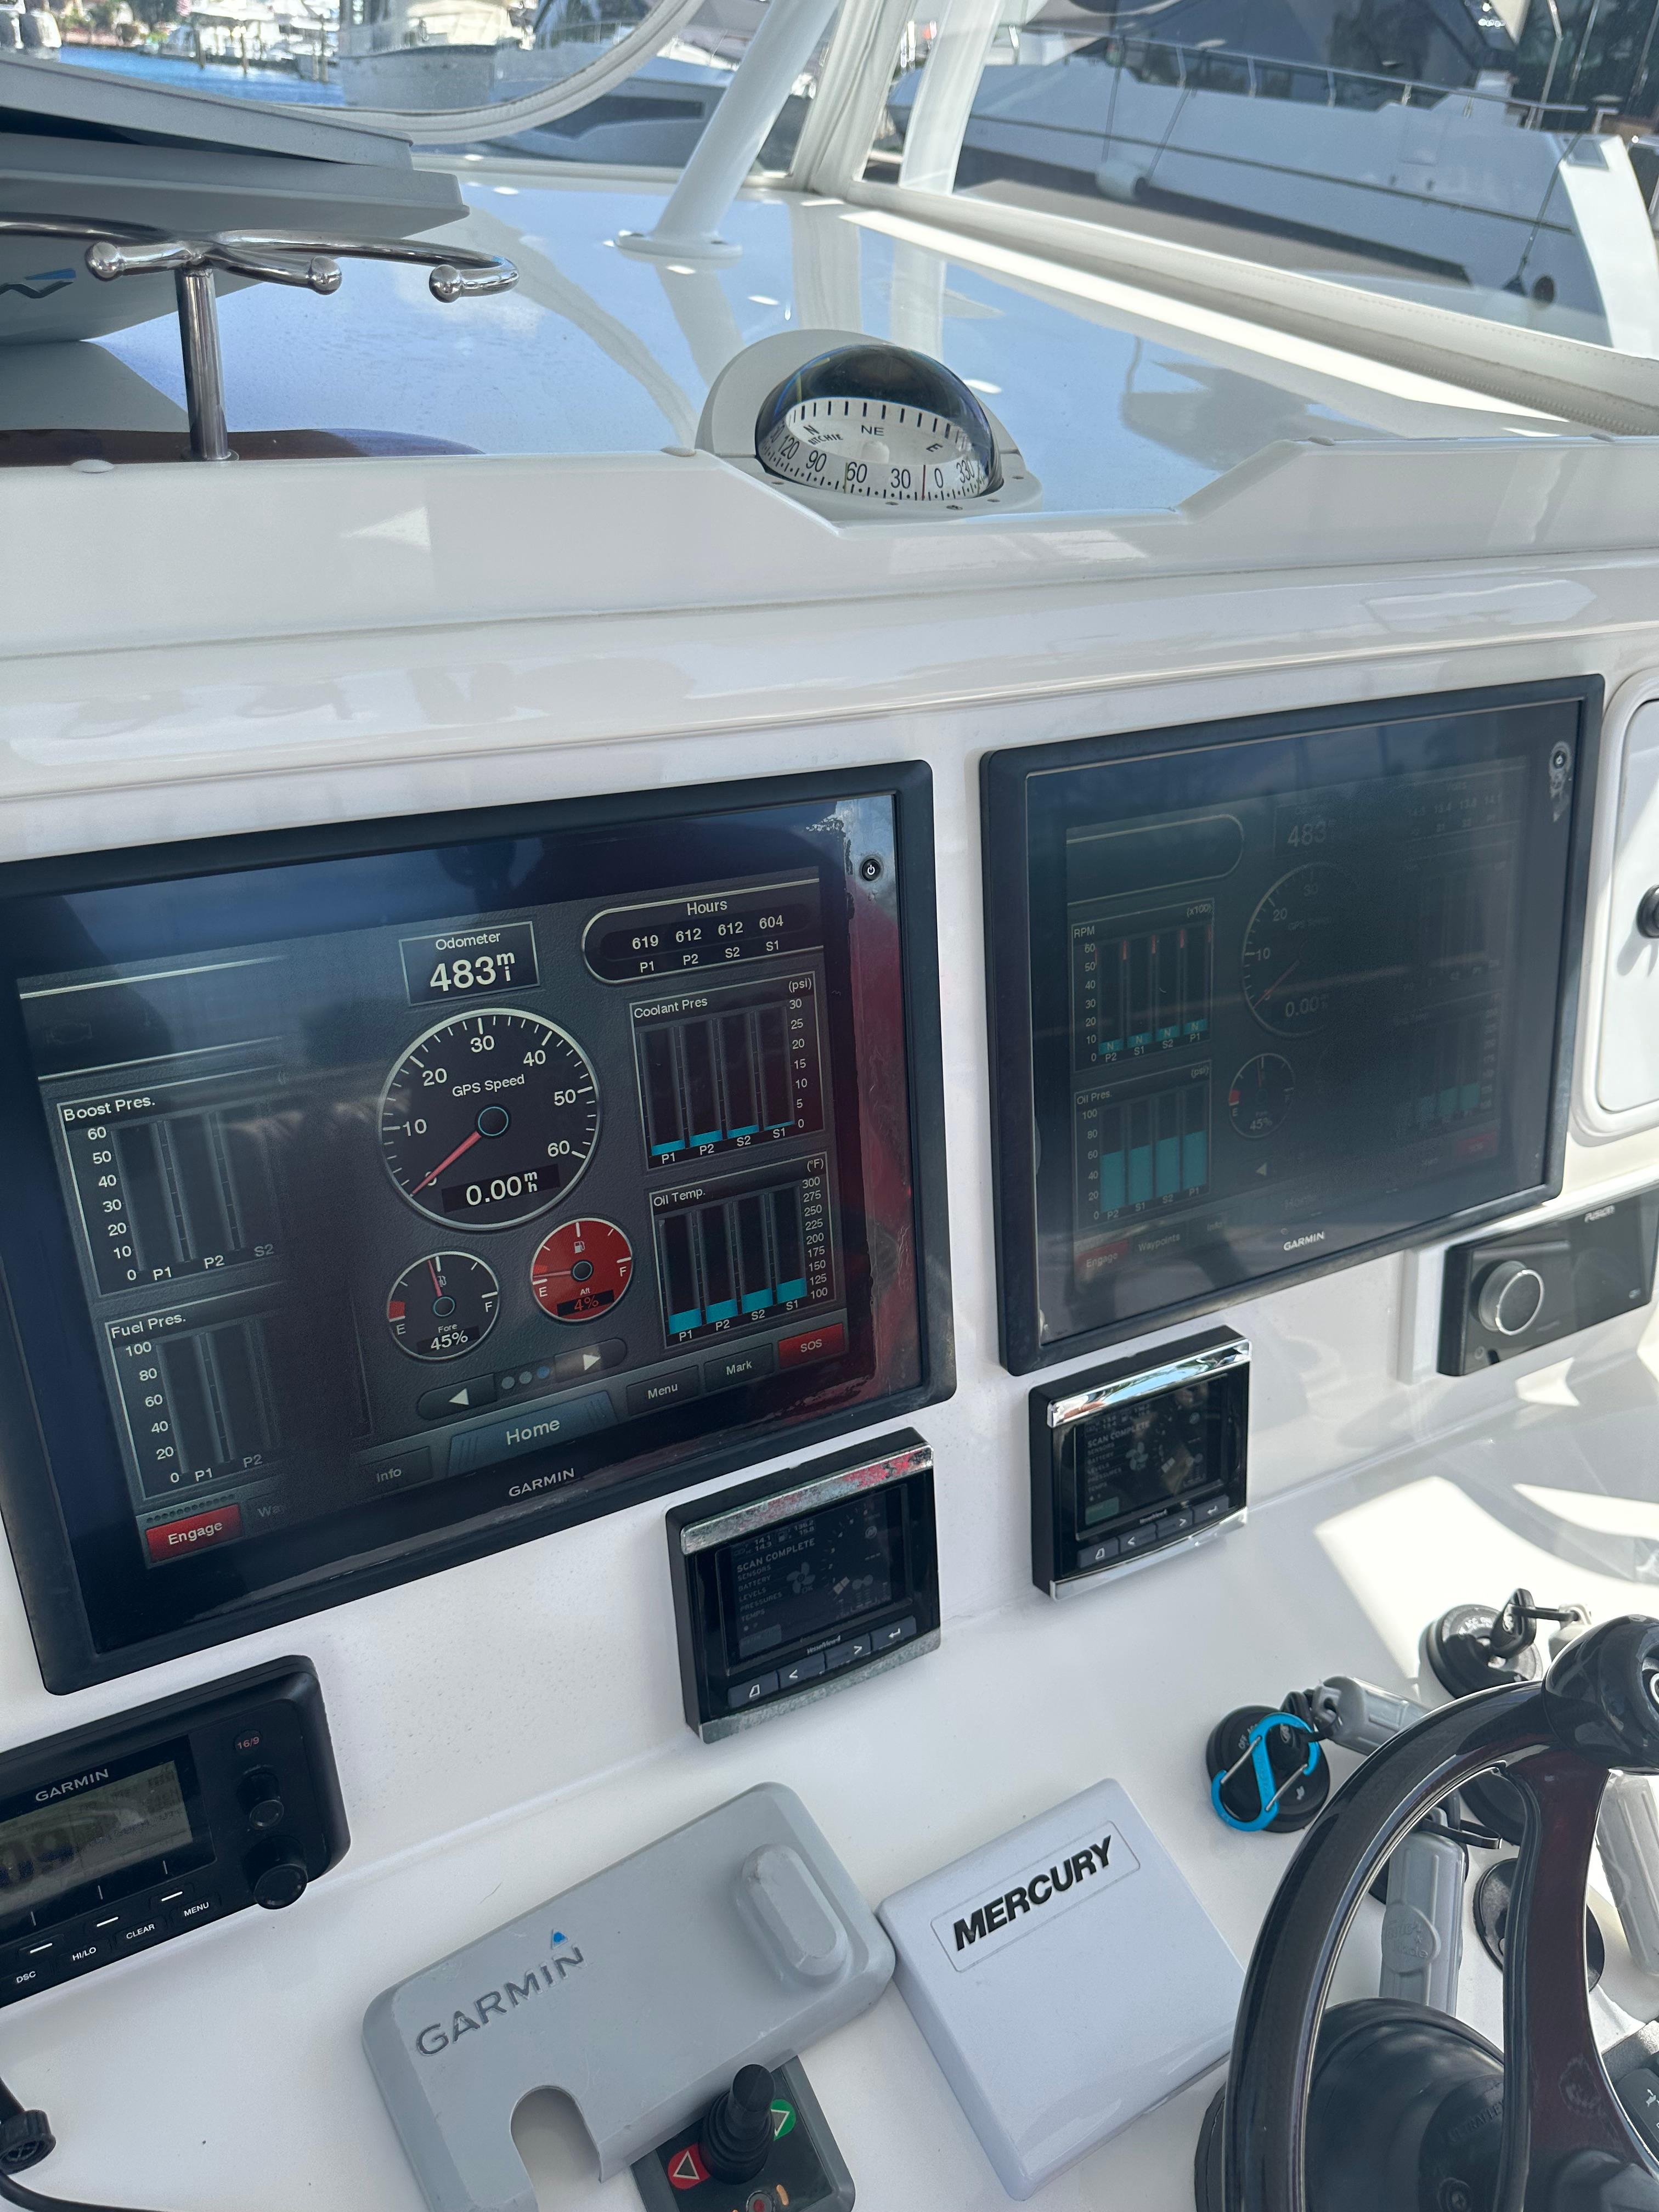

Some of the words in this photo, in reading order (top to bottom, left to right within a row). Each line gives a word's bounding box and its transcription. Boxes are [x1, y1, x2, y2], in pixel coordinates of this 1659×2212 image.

[803, 424, 820, 436] N
[860, 425, 885, 437] NE
[777, 435, 800, 460] 120
[926, 443, 944, 453] E
[805, 450, 827, 472] 90
[847, 461, 867, 483] 60
[890, 468, 911, 489] 30
[934, 468, 944, 488] 0
[956, 459, 975, 484] 330
[686, 899, 728, 916] Hours
[1273, 908, 1288, 922] 20
[631, 934, 659, 950] 619
[675, 928, 702, 943] 612
[718, 921, 743, 936] 612
[759, 915, 784, 930] 604
[1074, 926, 1095, 939] RPM
[435, 932, 501, 952] Odometer
[1084, 944, 1096, 953] 60
[640, 961, 656, 973] P1
[682, 953, 699, 966] P2
[725, 946, 740, 959] S2
[766, 940, 780, 952] S1
[1255, 947, 1271, 960] 10
[430, 956, 496, 992] 483
[1085, 962, 1096, 972] 50
[788, 978, 812, 993] (psi)
[1085, 980, 1096, 990] 40
[634, 1002, 679, 1019] Coolant
[682, 996, 708, 1013] Pres
[789, 998, 803, 1009] 30
[1085, 998, 1096, 1008] 30
[790, 1018, 804, 1030] 25
[1085, 1017, 1096, 1028] 20
[470, 1036, 495, 1053] 30
[792, 1038, 805, 1050] 20
[1086, 1034, 1097, 1044] 10
[1105, 1053, 1118, 1063] P2
[1134, 1046, 1145, 1056] S1
[1163, 1039, 1173, 1049] S2
[1190, 1032, 1200, 1042] P1
[523, 1049, 546, 1067] 40
[793, 1058, 807, 1070] 15
[1091, 1053, 1097, 1062] 0
[422, 1068, 448, 1086] 20
[795, 1078, 808, 1089] 10
[452, 1082, 481, 1098] GPS
[484, 1074, 525, 1092] Speed
[554, 1088, 576, 1105] 50
[1077, 1093, 1088, 1105] Oil
[64, 1103, 111, 1121] Boost
[115, 1096, 155, 1112] Pres.
[796, 1099, 803, 1109] 5
[1082, 1109, 1098, 1120] 100
[402, 1119, 428, 1136] 10
[797, 1118, 805, 1129] 0
[87, 1127, 106, 1140] 60
[1087, 1130, 1098, 1139] 80
[547, 1140, 571, 1157] 60
[661, 1152, 676, 1164] P1
[699, 1143, 714, 1155] P2
[736, 1135, 751, 1147] S2
[772, 1127, 786, 1138] S1
[93, 1150, 112, 1164] 50
[1087, 1150, 1098, 1160] 60
[98, 1175, 117, 1188] 40
[802, 1177, 821, 1188] 300
[1088, 1170, 1098, 1181] 40
[465, 1176, 522, 1206] 0.00
[653, 1194, 669, 1207] Oil
[673, 1189, 706, 1204] Temp.
[803, 1190, 821, 1203] 275
[1088, 1190, 1099, 1201] 20
[103, 1199, 122, 1213] 30
[804, 1204, 822, 1216] 250
[1107, 1210, 1119, 1220] P2
[1135, 1202, 1146, 1212] S1
[1163, 1194, 1173, 1204] S2
[1189, 1187, 1199, 1197] P1
[1093, 1211, 1099, 1220] 0
[108, 1223, 127, 1237] 20
[805, 1218, 823, 1231] 225
[806, 1233, 824, 1245] 200
[1283, 1231, 1325, 1251] GARMIN
[114, 1246, 132, 1259] 10
[808, 1246, 825, 1258] 175
[153, 1267, 172, 1281] P1
[204, 1255, 225, 1269] P2
[253, 1244, 274, 1257] S2
[809, 1260, 826, 1272] 150
[127, 1270, 137, 1281] 0
[619, 1266, 627, 1277] F
[810, 1274, 827, 1285] 125
[539, 1286, 548, 1297] E
[580, 1287, 590, 1295] Aft
[810, 1288, 828, 1300] 100
[485, 1302, 493, 1312] F
[574, 1298, 600, 1312] 4%
[111, 1322, 144, 1339] Fuel
[148, 1313, 186, 1330] Pres.
[679, 1330, 693, 1342] P1
[715, 1319, 730, 1331] P2
[751, 1309, 765, 1321] S2
[786, 1299, 799, 1310] S1
[396, 1324, 406, 1335] E
[438, 1323, 458, 1334] Fore
[430, 1330, 469, 1351] 45%
[800, 1339, 823, 1353] SOS
[126, 1342, 152, 1357] 100
[139, 1368, 157, 1381] 80
[726, 1360, 752, 1375] Mark
[647, 1383, 679, 1400] Menu
[145, 1395, 163, 1408] 60
[151, 1421, 168, 1434] 40
[506, 1419, 561, 1446] Home
[1087, 1435, 1109, 1448] SCAN
[156, 1446, 174, 1460] 20
[195, 1468, 213, 1482] P1
[243, 1454, 263, 1468] P2
[376, 1467, 402, 1483] Info
[170, 1472, 180, 1483] 0
[508, 1468, 575, 1498] GARMIN
[168, 1521, 223, 1545] Engage
[737, 1558, 763, 1573] SCAN
[766, 1538, 815, 1563] COMPLETE
[737, 1565, 771, 1581] SENSORS
[738, 1575, 772, 1591] BATTERY
[739, 1588, 766, 1602] LEVELS
[740, 1592, 783, 1611] PRESSURES
[742, 1609, 765, 1621] TEMPS
[236, 1736, 260, 1750] 16/9
[1238, 1735, 1249, 1750] OFF
[35, 1768, 109, 1802] GARMIN
[953, 1834, 1111, 1951] MERCURY
[184, 1901, 210, 1917] MENU
[126, 1923, 155, 1939] CLEAR
[72, 1946, 97, 1961] HI/LO
[16, 1970, 37, 1984] DSC
[416, 1944, 588, 2056] GARMIN
